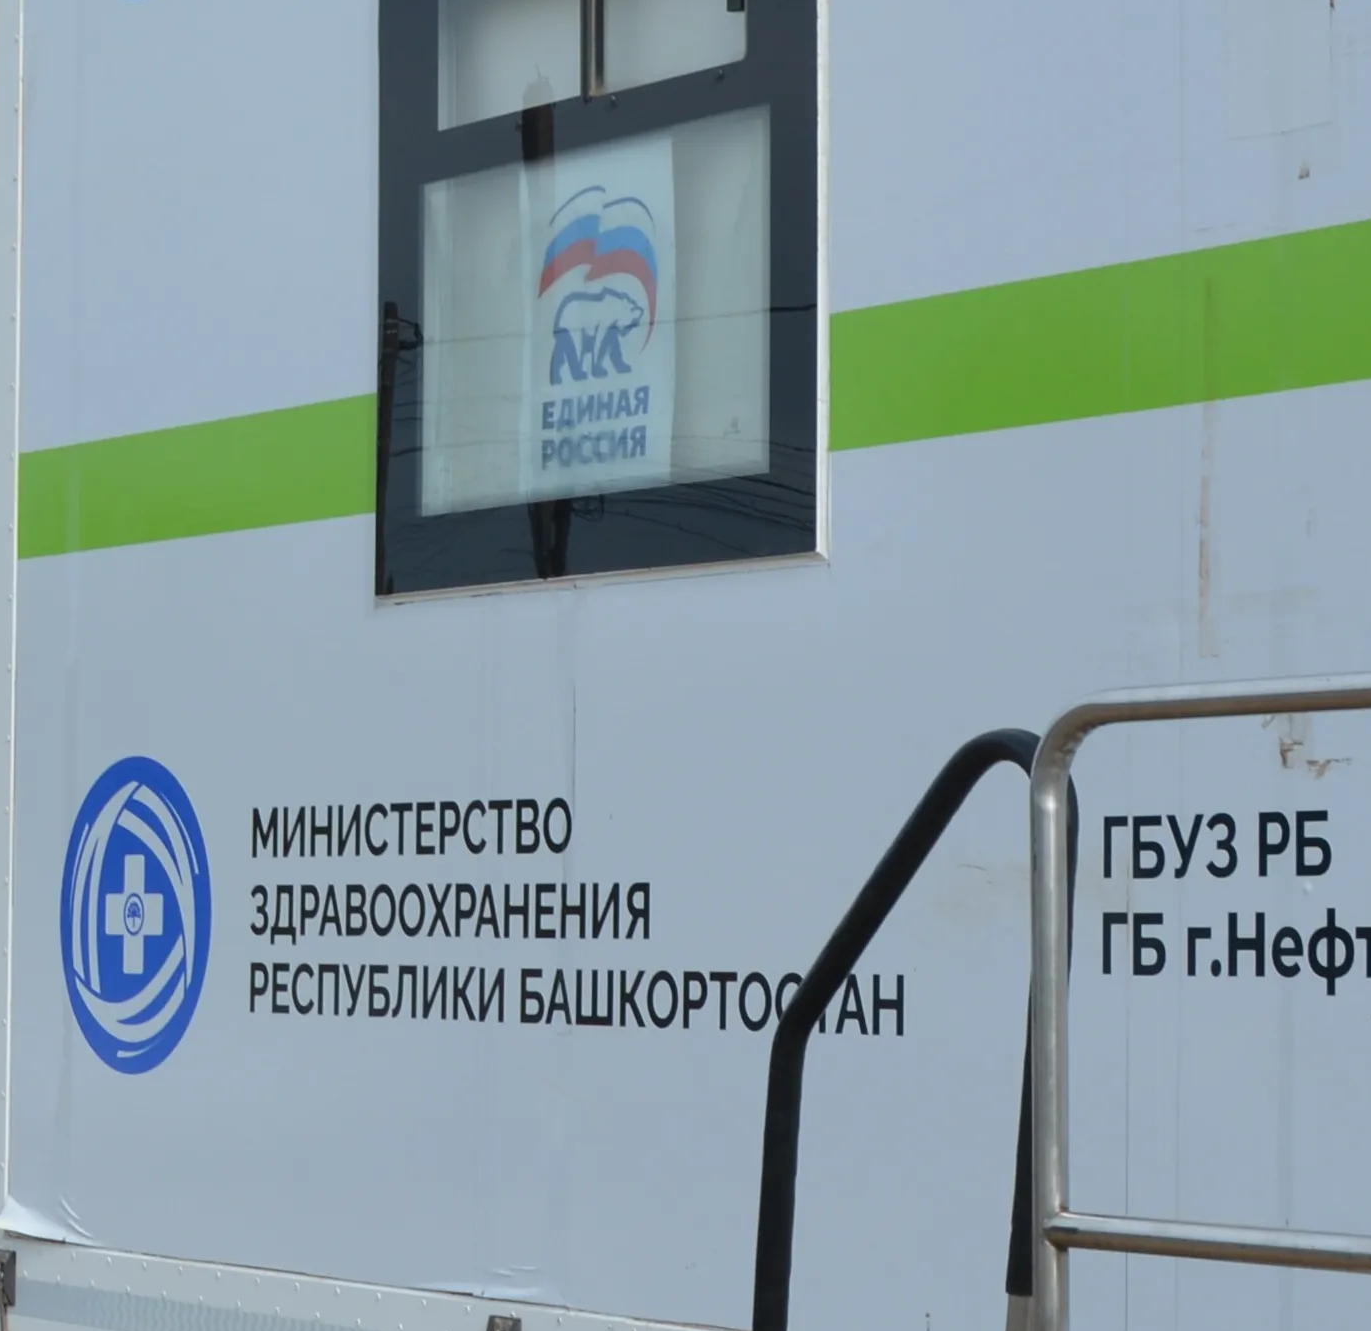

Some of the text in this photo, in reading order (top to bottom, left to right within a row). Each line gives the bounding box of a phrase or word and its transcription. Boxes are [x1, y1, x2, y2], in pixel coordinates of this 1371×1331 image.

[542, 385, 650, 432] ЕДИНАЯ
[542, 424, 647, 471] РОССИЯ
[251, 797, 573, 858] МИНИСТЕРСТВО
[1102, 809, 1333, 880] ГБУЗ РБ
[249, 881, 651, 946] ЗДРАВООХРАНЕНИЯ
[1101, 911, 1167, 977] ГБ
[249, 961, 506, 1024] РЕСПУБЛИКИ
